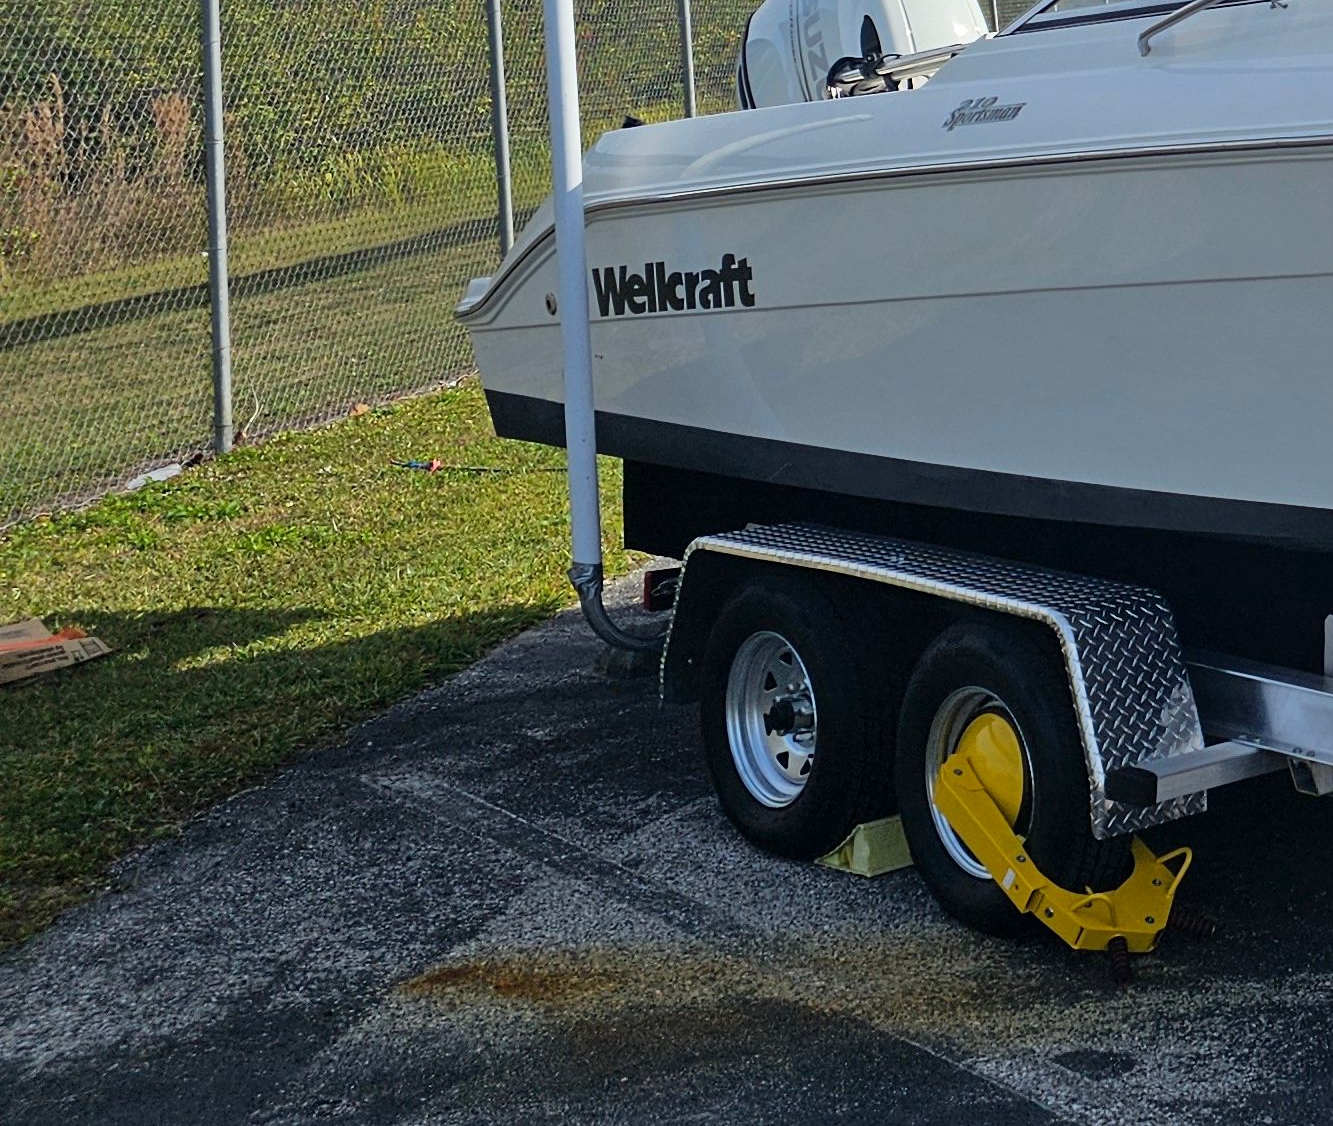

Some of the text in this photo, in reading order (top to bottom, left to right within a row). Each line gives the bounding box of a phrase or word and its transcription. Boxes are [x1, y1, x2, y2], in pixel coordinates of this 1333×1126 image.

[942, 103, 1027, 131] Sportsman
[957, 96, 998, 110] 210
[591, 253, 756, 317] Wellcraft
